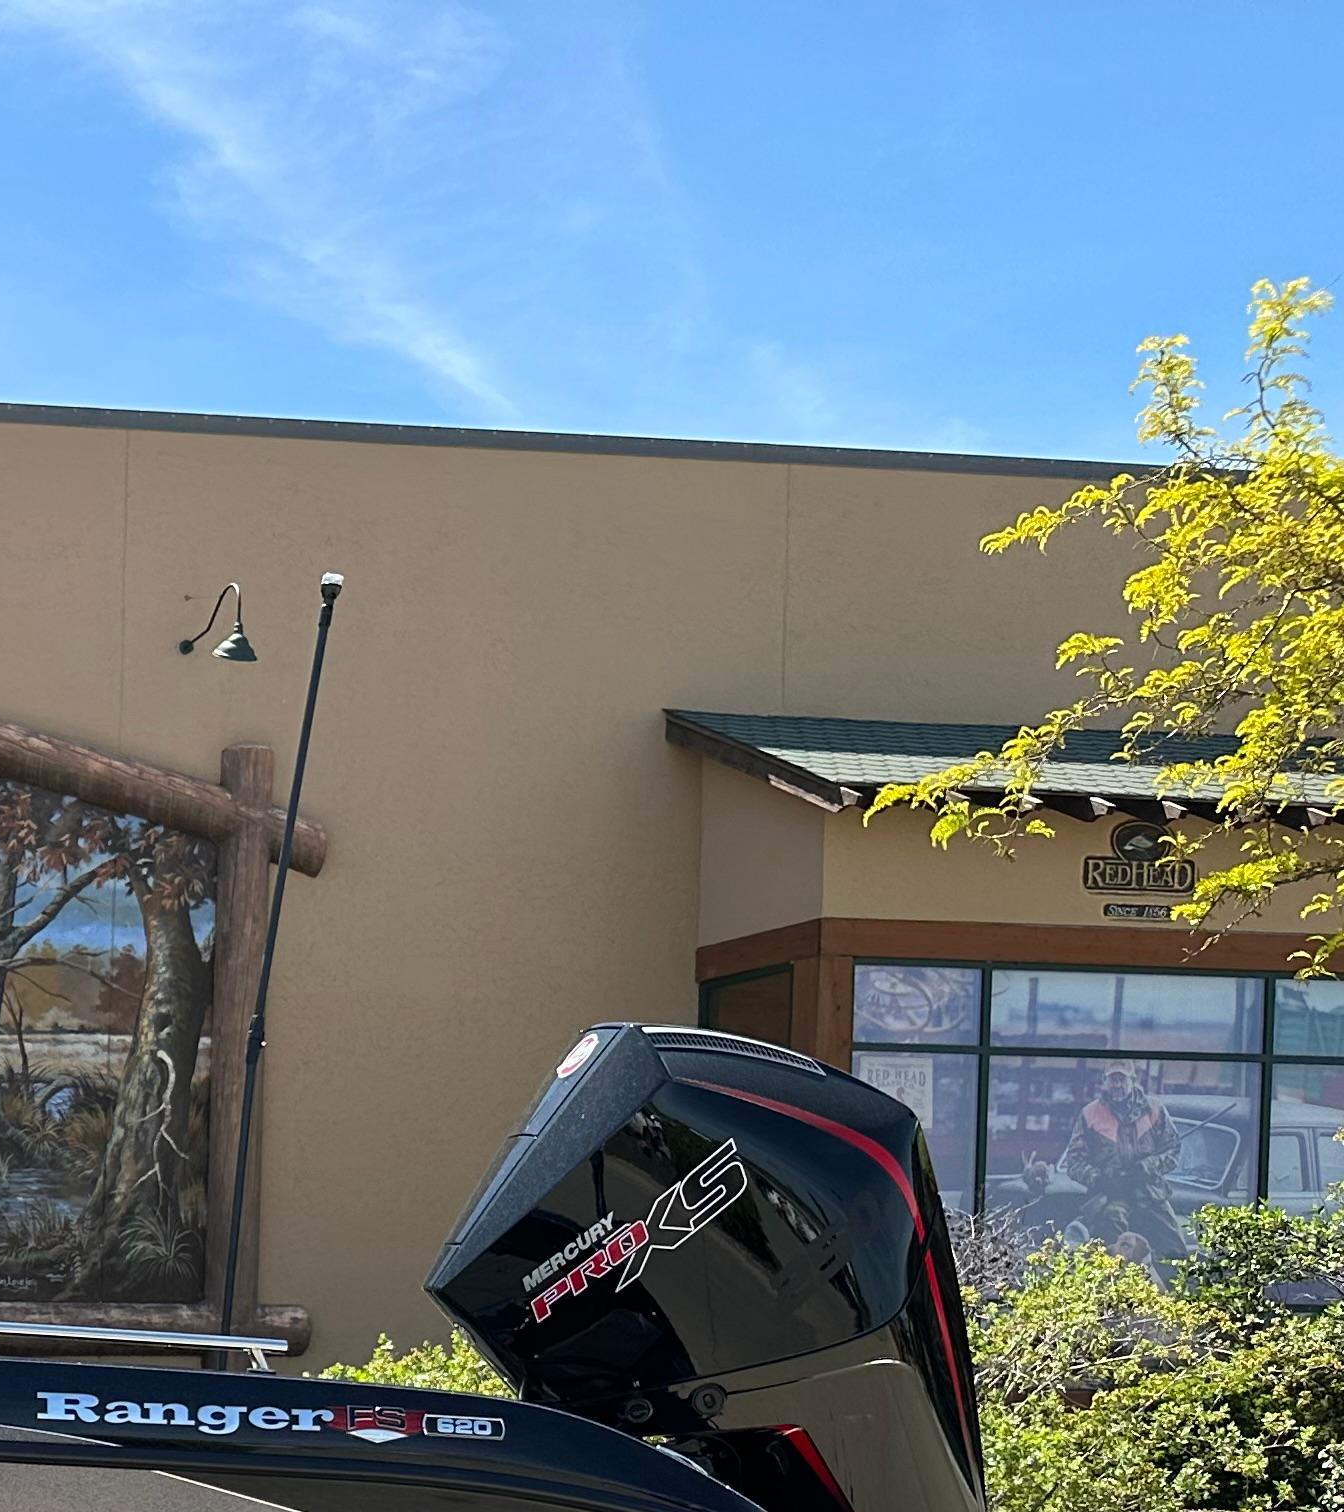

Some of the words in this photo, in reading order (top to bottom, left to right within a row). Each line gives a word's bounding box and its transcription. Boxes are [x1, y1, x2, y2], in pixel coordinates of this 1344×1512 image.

[1107, 905, 1139, 917] SINCE
[867, 1068, 890, 1082] RED
[895, 1069, 927, 1087] HEAD
[522, 1211, 614, 1292] MERCURY
[531, 1220, 649, 1323] PRO
[615, 1138, 748, 1293] XS
[36, 1391, 334, 1434] Ranger
[346, 1405, 407, 1431] FS
[437, 1418, 491, 1435] 620
